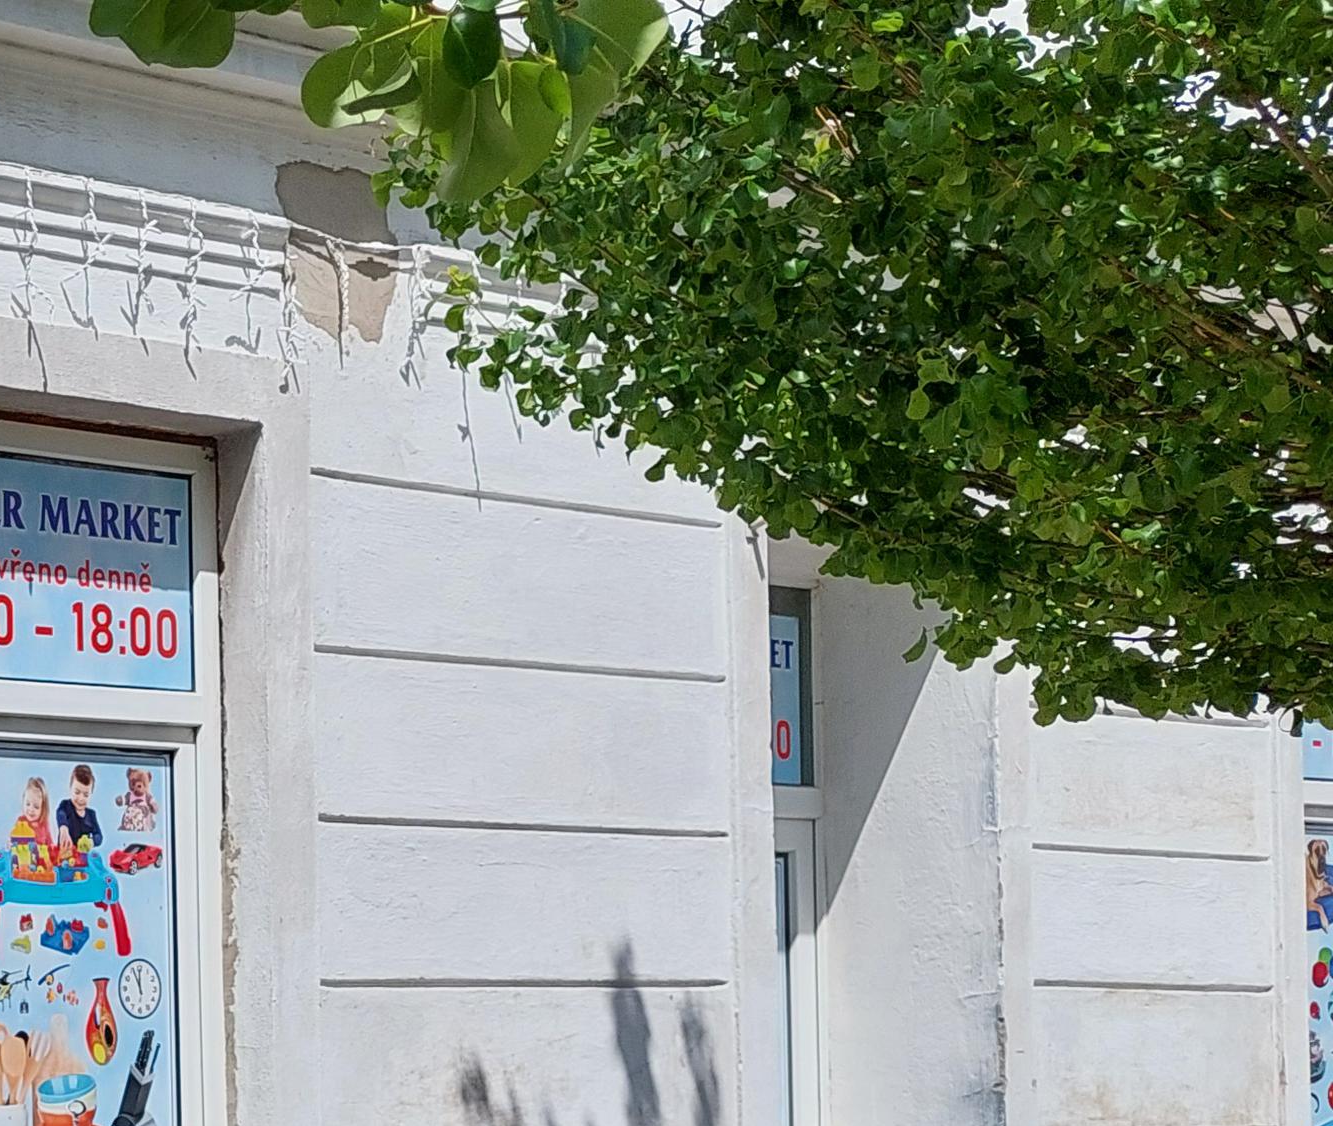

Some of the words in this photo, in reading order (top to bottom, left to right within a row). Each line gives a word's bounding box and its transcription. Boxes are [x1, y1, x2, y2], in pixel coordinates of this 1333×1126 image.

[39, 494, 181, 546] MARKET
[78, 560, 152, 593] denně
[71, 602, 178, 659] 18:00
[776, 719, 791, 760] 0
